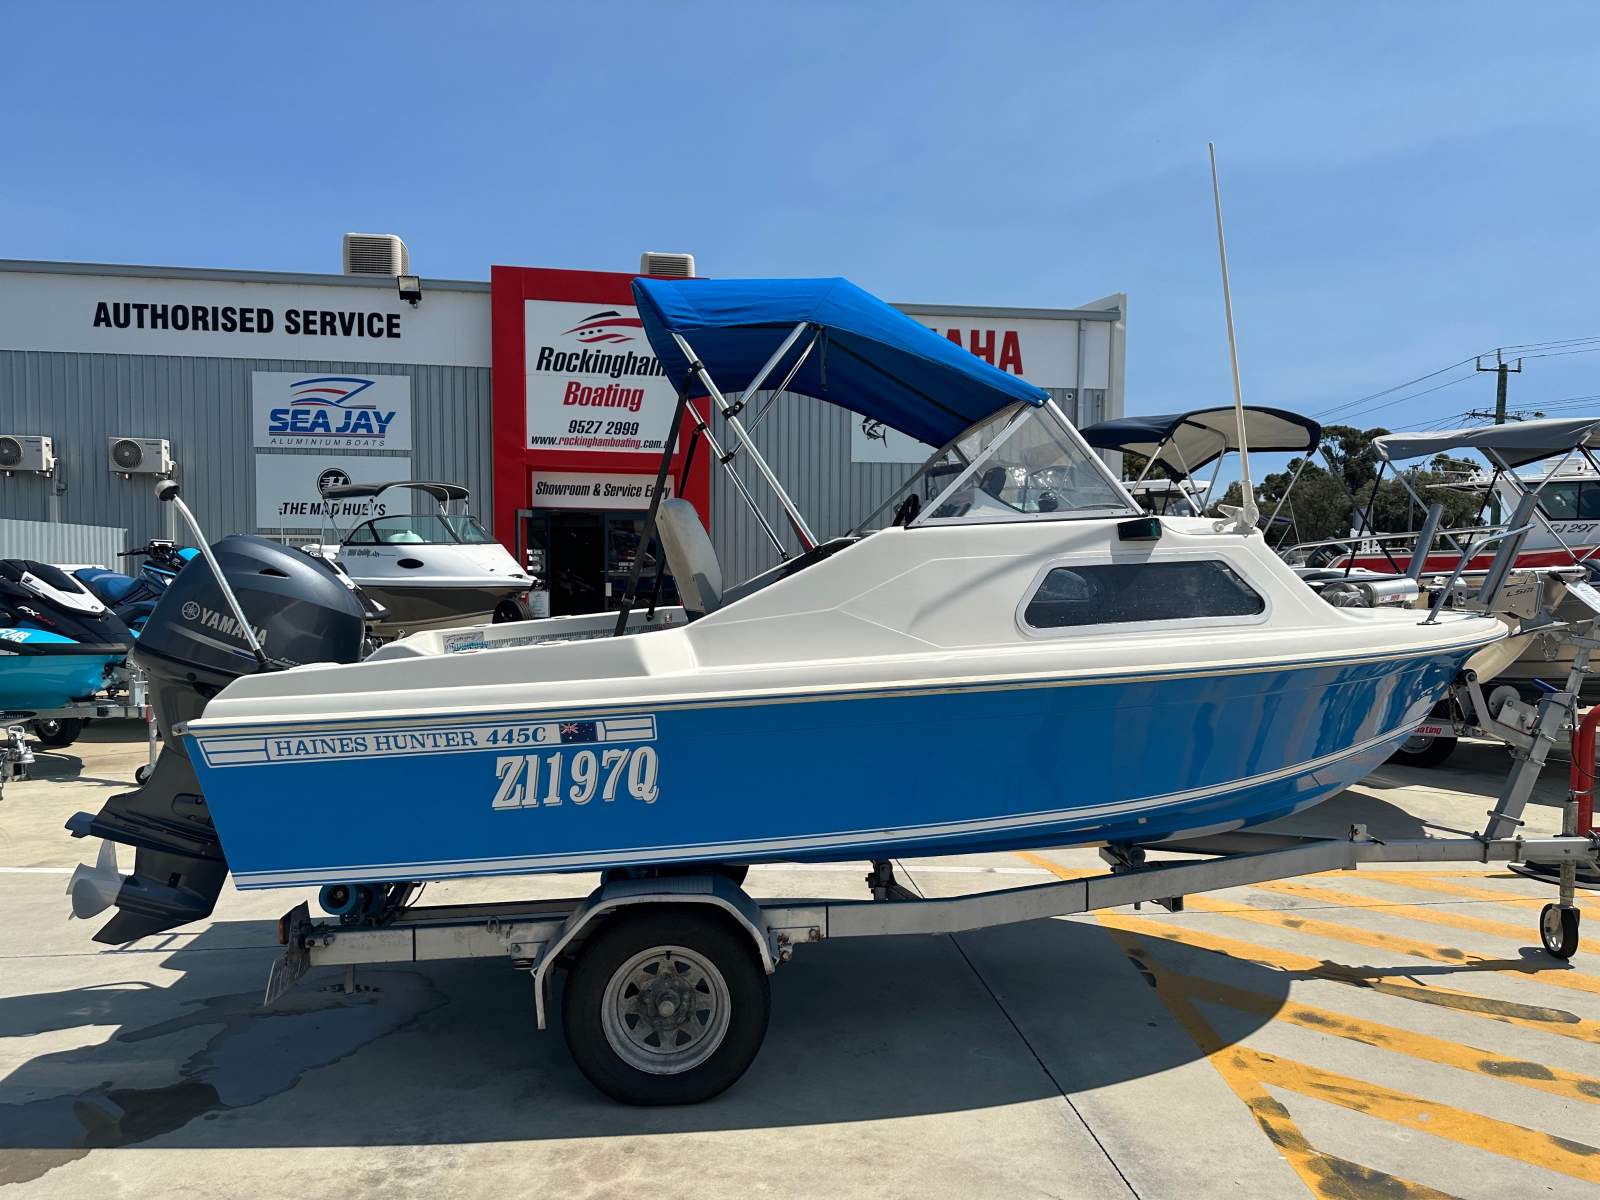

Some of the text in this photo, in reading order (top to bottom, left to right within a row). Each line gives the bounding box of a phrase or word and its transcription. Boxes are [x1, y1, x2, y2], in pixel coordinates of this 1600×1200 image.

[93, 301, 402, 338] AUTHORISED SERVICE
[563, 381, 645, 412] Boating
[269, 408, 397, 434] SEA JAY
[568, 419, 640, 436] 9527 2999
[271, 438, 341, 446] ALUMINIUM
[535, 481, 591, 497] Showroom
[593, 483, 601, 496] &
[603, 483, 643, 498] Service
[282, 502, 308, 515] THE
[310, 502, 340, 516] MAD
[274, 725, 547, 758] HAINES HUNTER 445C
